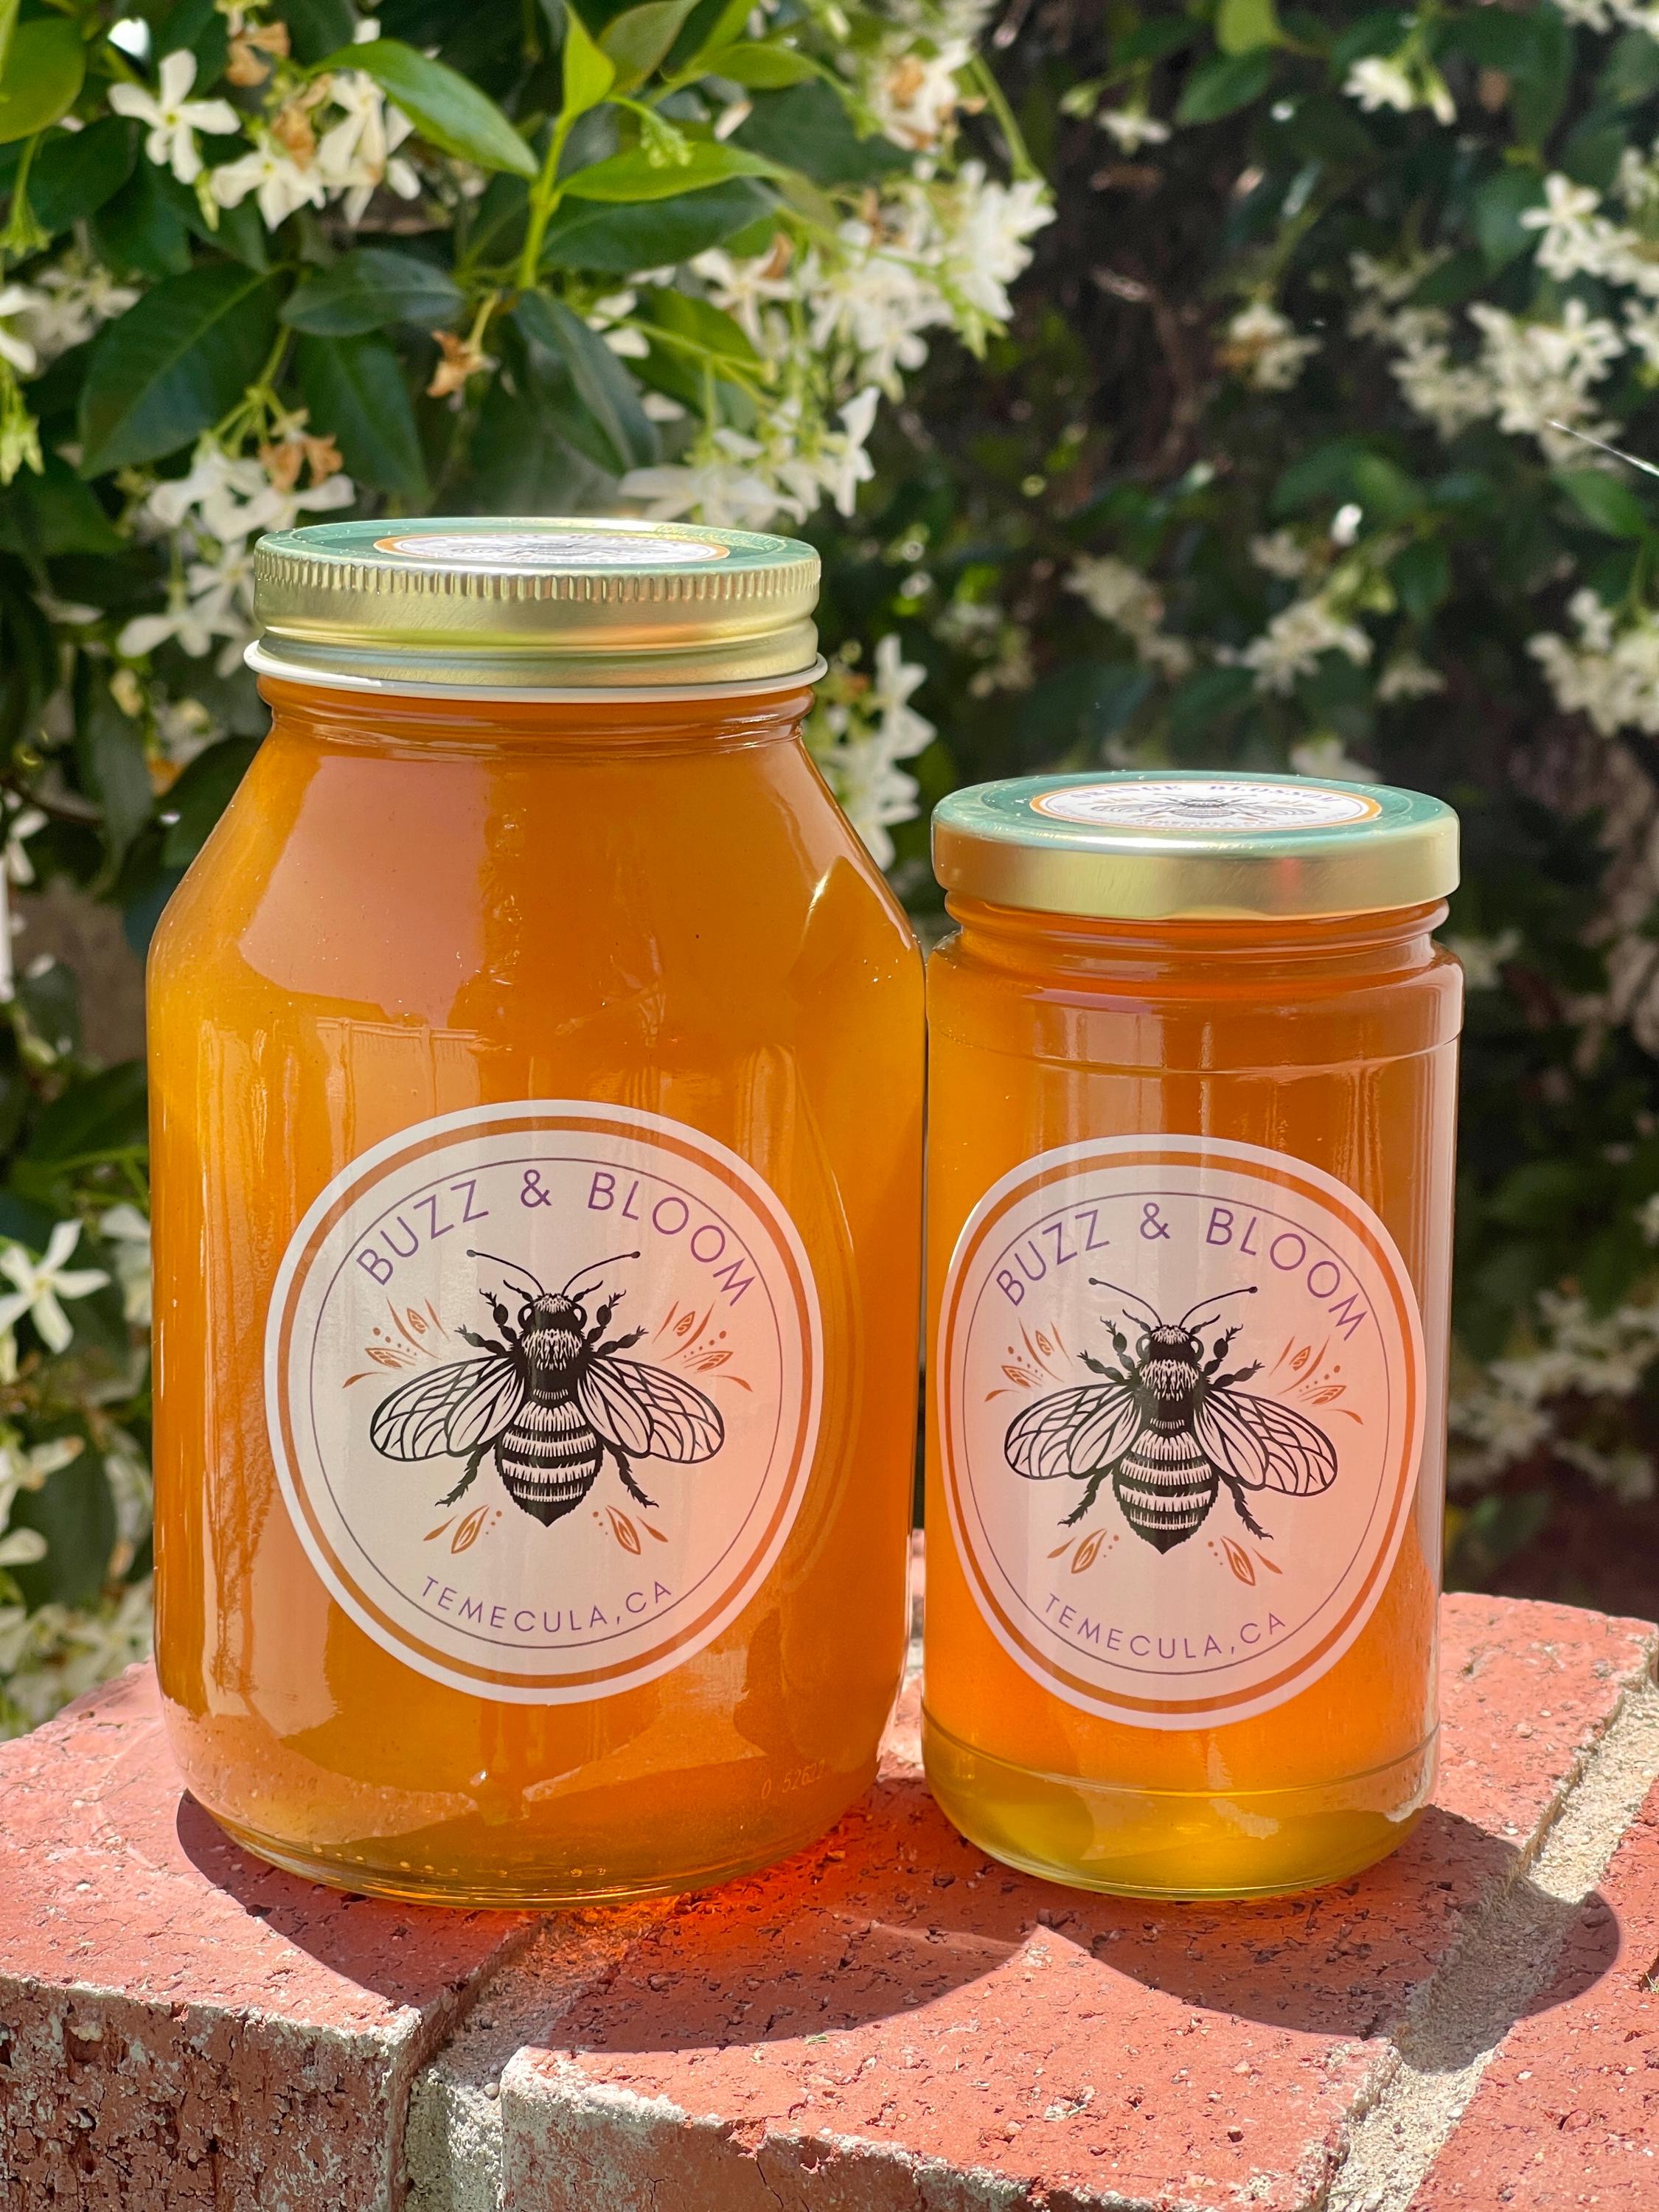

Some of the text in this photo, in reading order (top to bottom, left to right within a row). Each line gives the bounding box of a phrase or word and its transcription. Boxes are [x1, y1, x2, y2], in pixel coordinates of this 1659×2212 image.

[356, 1169, 755, 1306] BUZZ & BLOOM
[997, 1203, 1366, 1340] BUZZ & BLOOM
